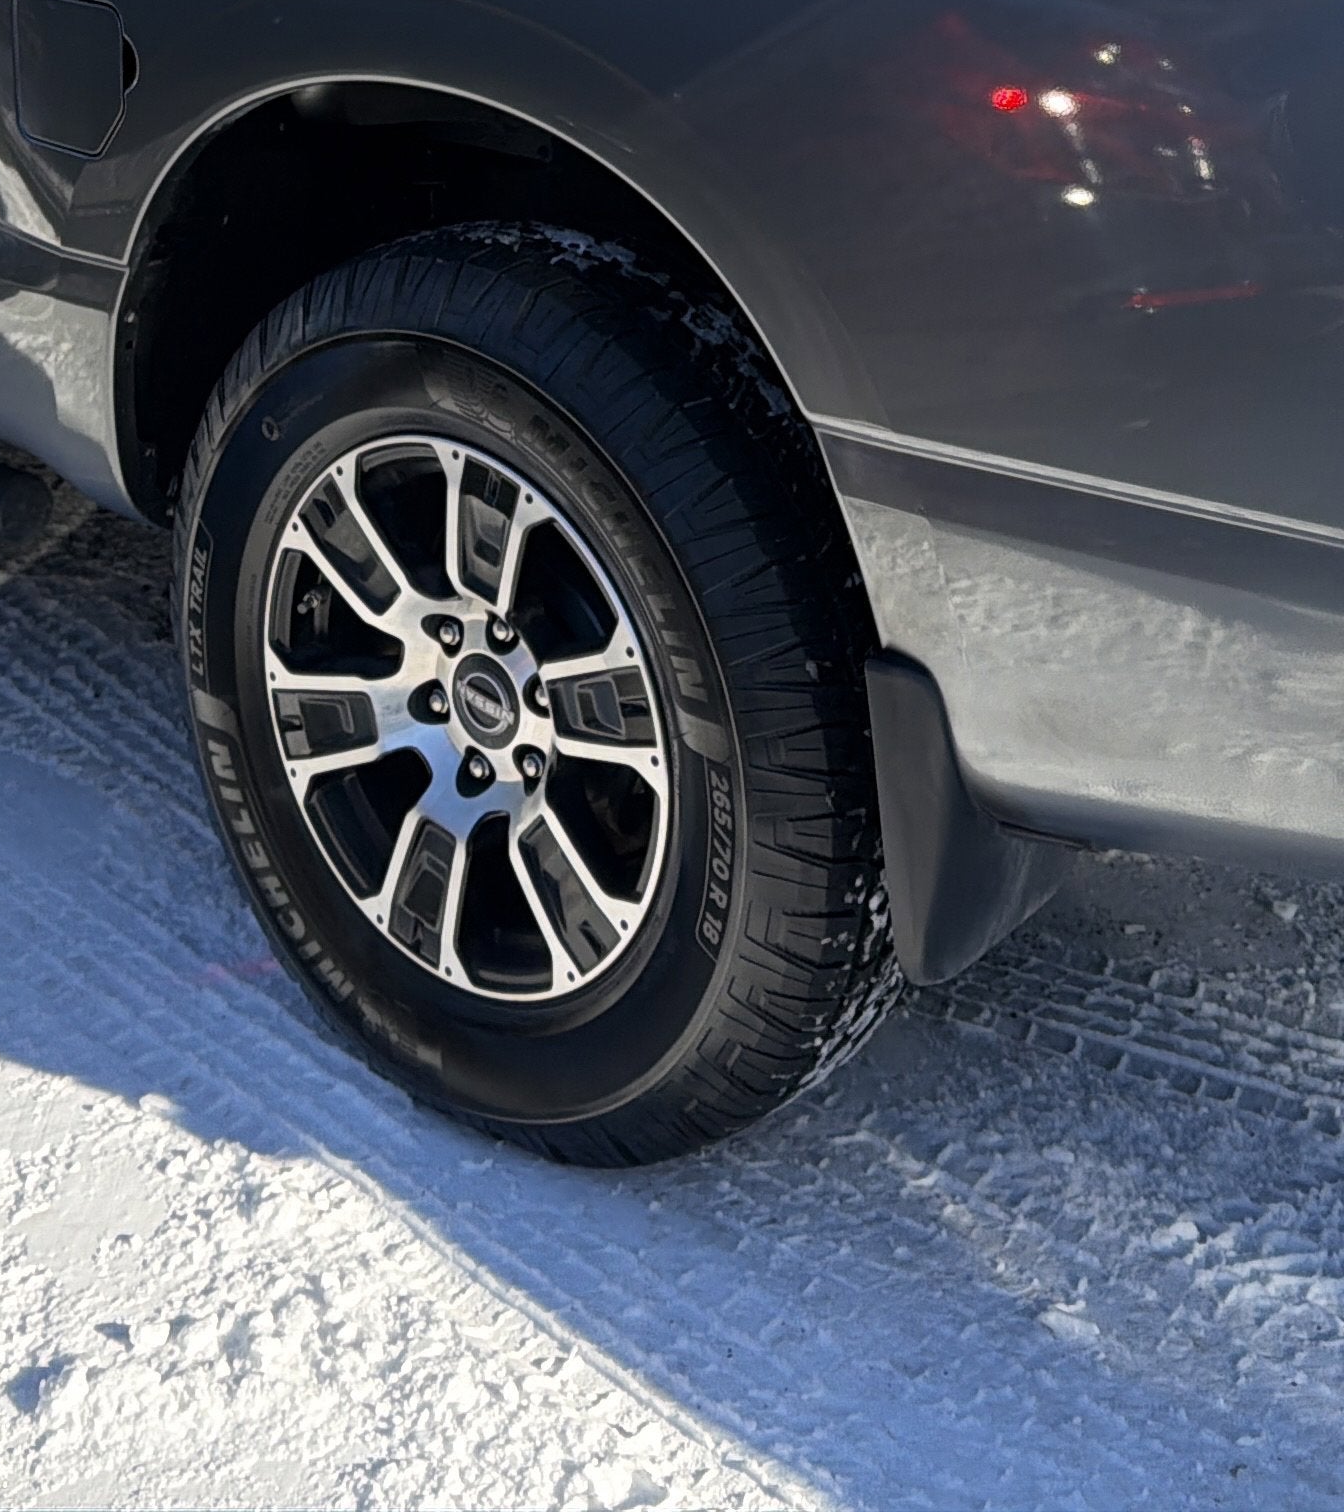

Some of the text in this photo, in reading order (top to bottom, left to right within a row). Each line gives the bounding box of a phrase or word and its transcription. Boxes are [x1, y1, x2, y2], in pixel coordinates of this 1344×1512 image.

[189, 546, 208, 677] LTX TRAIL
[520, 414, 710, 703] MICHELIN
[456, 679, 516, 726] NISSAN
[207, 739, 355, 1003] MICHELIN
[702, 769, 733, 946] 265/70 R 18
